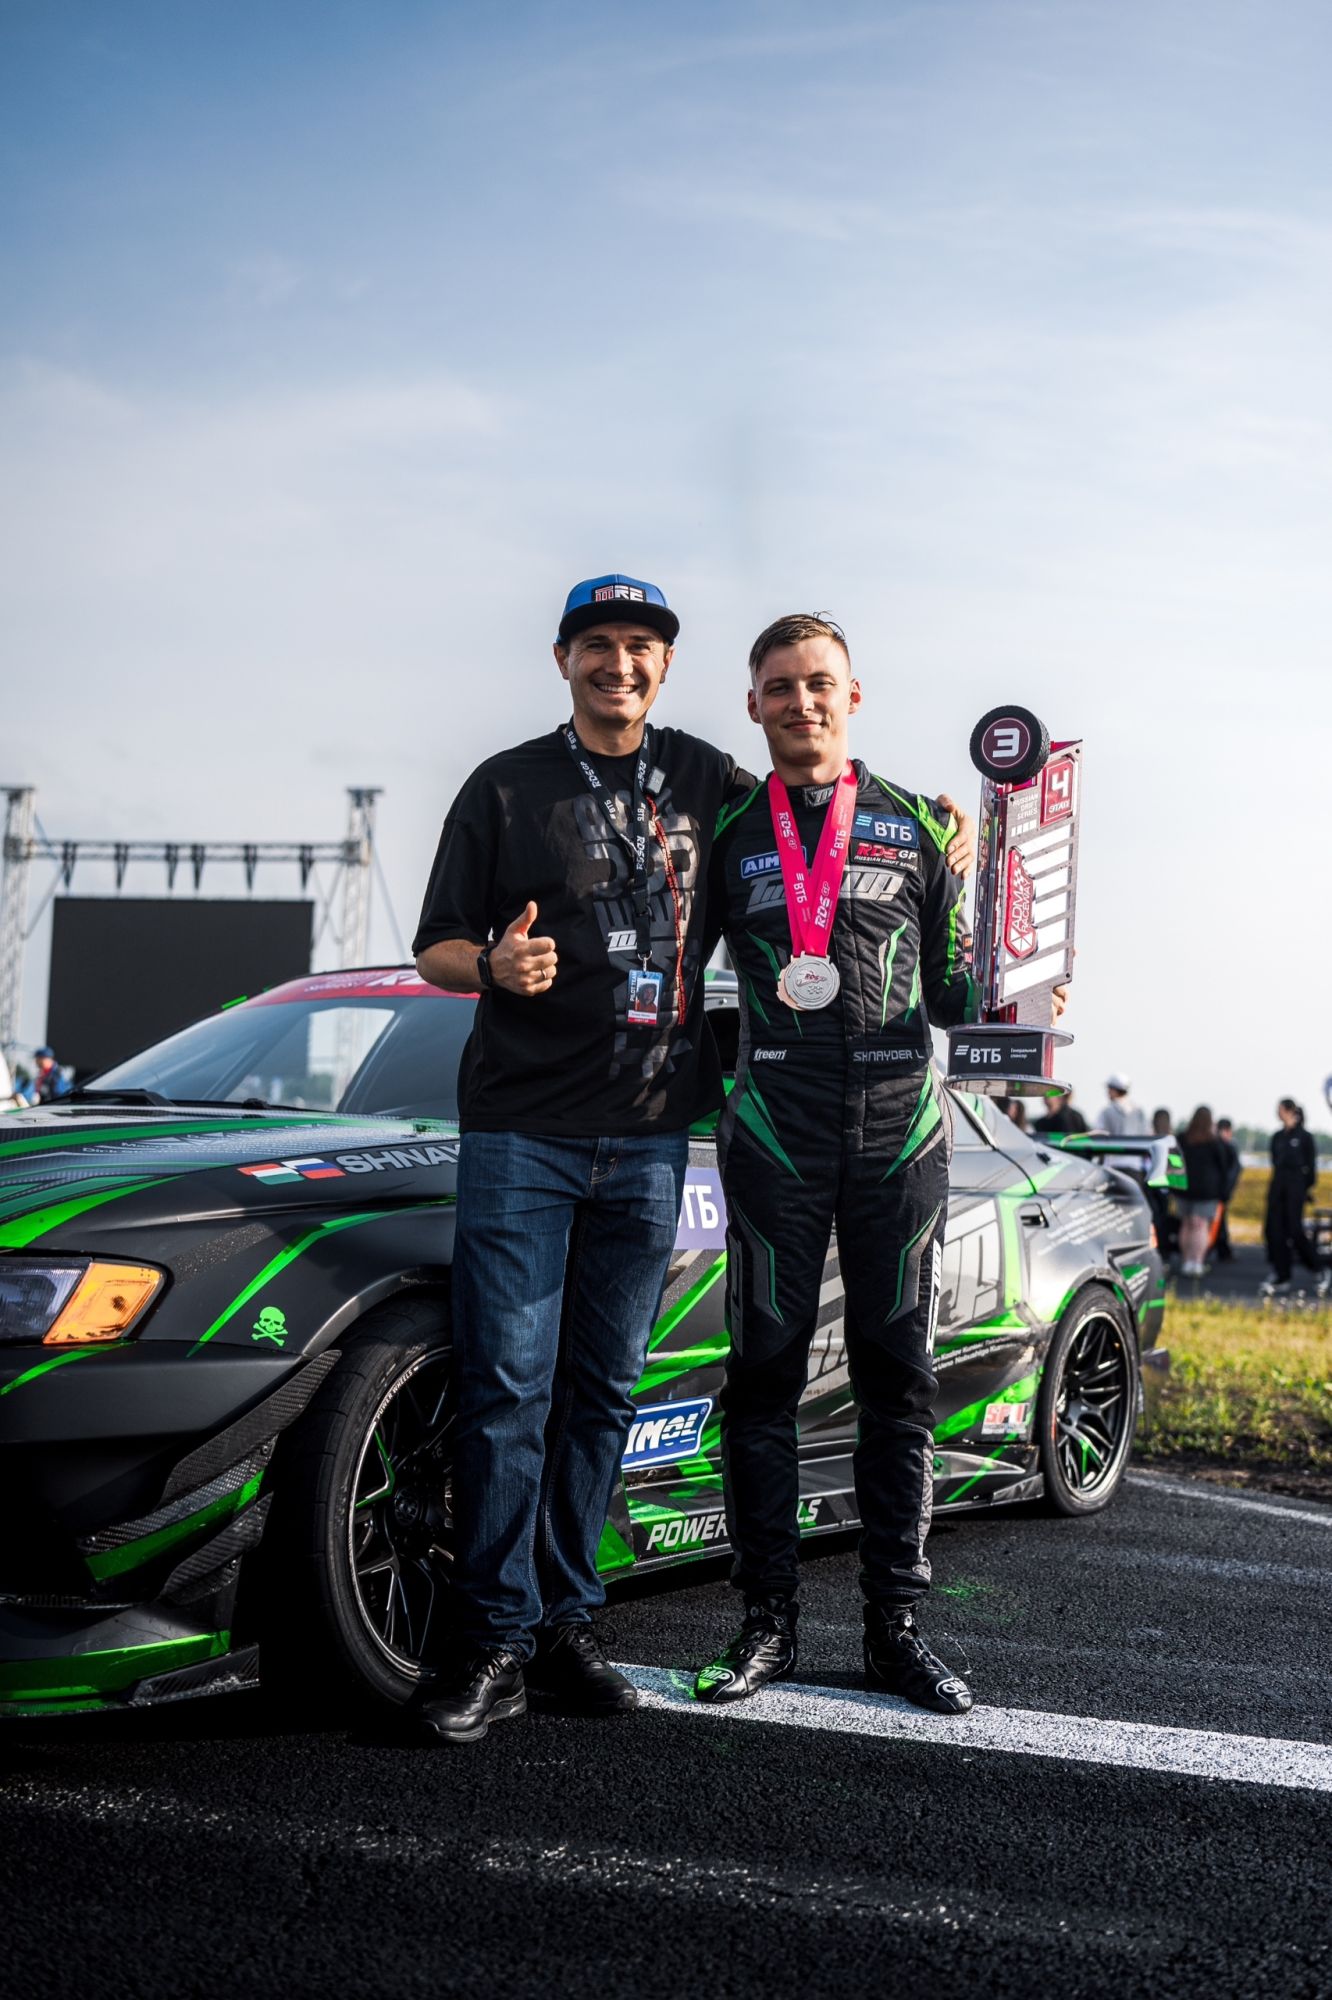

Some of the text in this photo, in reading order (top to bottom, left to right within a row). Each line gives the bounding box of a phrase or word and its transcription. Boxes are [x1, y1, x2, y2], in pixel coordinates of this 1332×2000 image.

[992, 728, 1020, 758] 3
[1052, 768, 1068, 797] 4
[779, 811, 795, 838] RDS
[874, 821, 912, 842] ВТБ
[834, 830, 847, 849] ВТБ
[743, 855, 780, 875] AIM
[793, 882, 807, 903] ВТБ
[814, 896, 830, 929] RDS
[853, 1050, 913, 1062] SHNAYDER
[970, 1047, 1002, 1064] ВТБ
[678, 1184, 719, 1229] ТБ
[942, 1680, 968, 1693] OM
